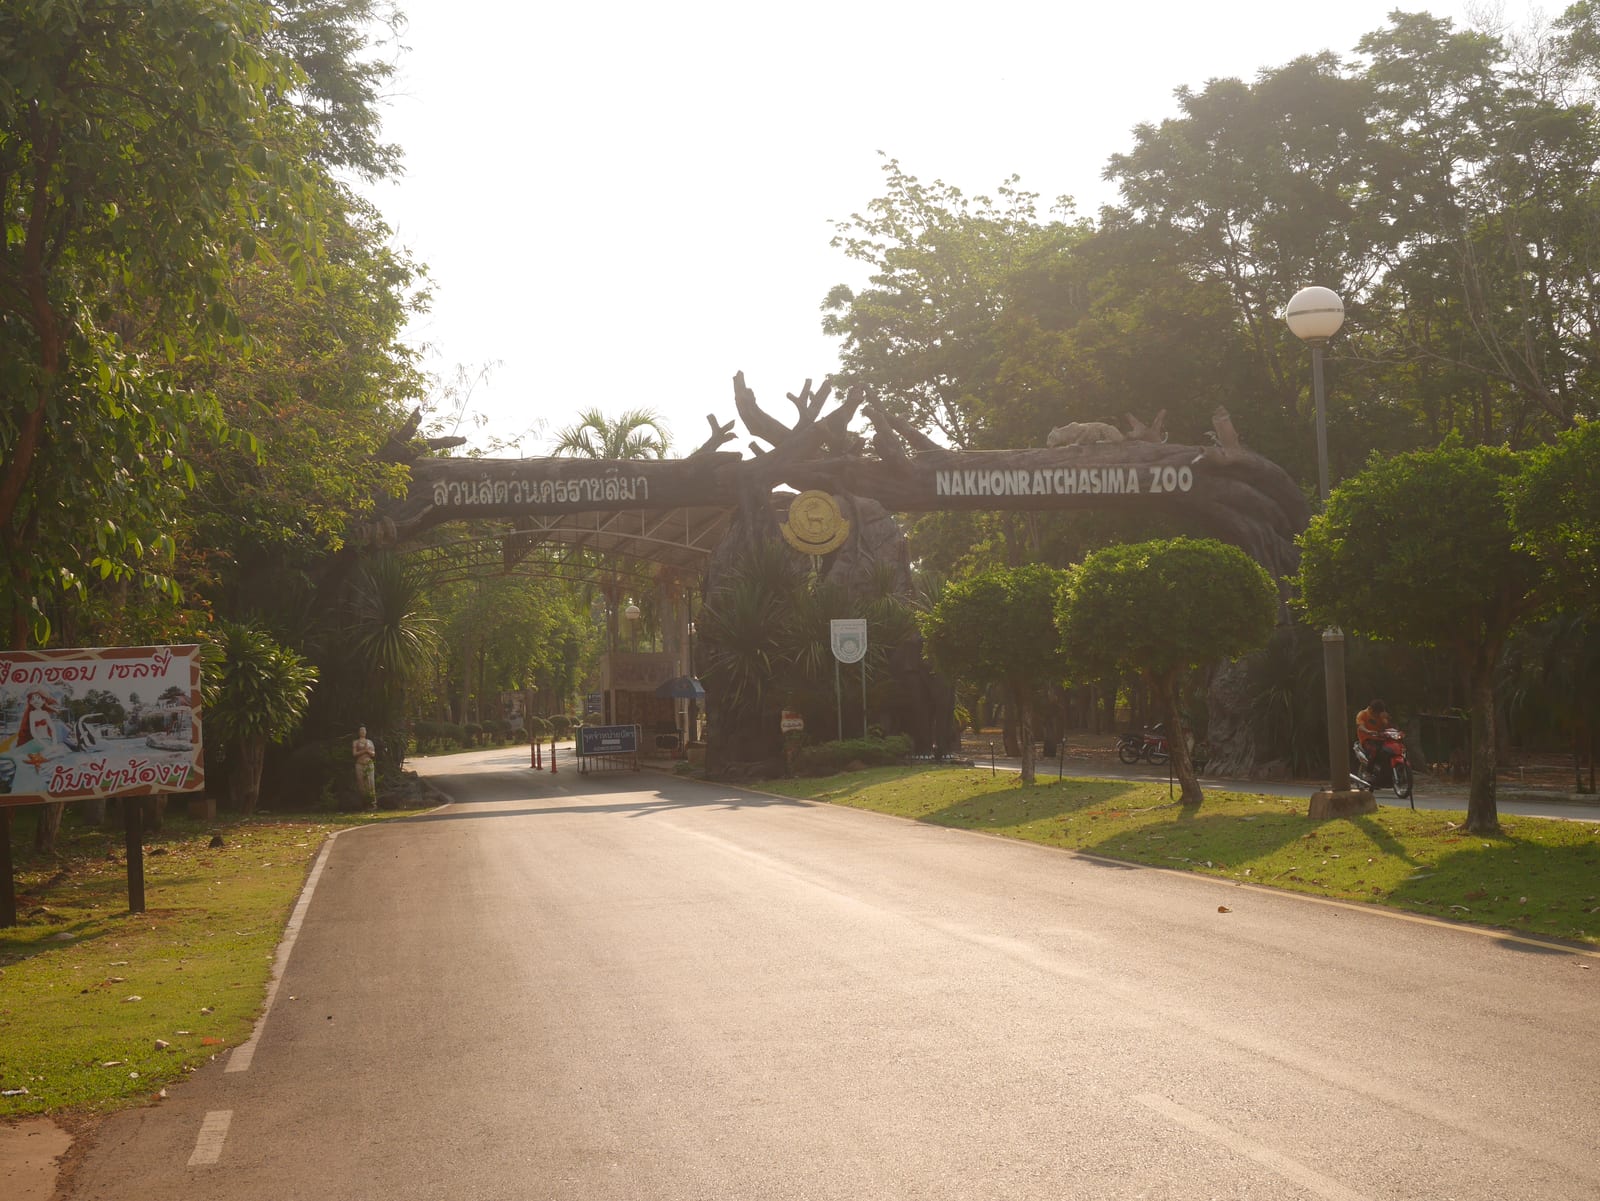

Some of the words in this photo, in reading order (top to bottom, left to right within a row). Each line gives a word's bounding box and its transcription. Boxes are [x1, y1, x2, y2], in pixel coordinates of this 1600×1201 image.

[433, 468, 648, 505] สวนสัตว์นครราชสีมา
[936, 468, 1140, 495] NAKHONRATCHASIMA
[1150, 466, 1193, 493] ZOO
